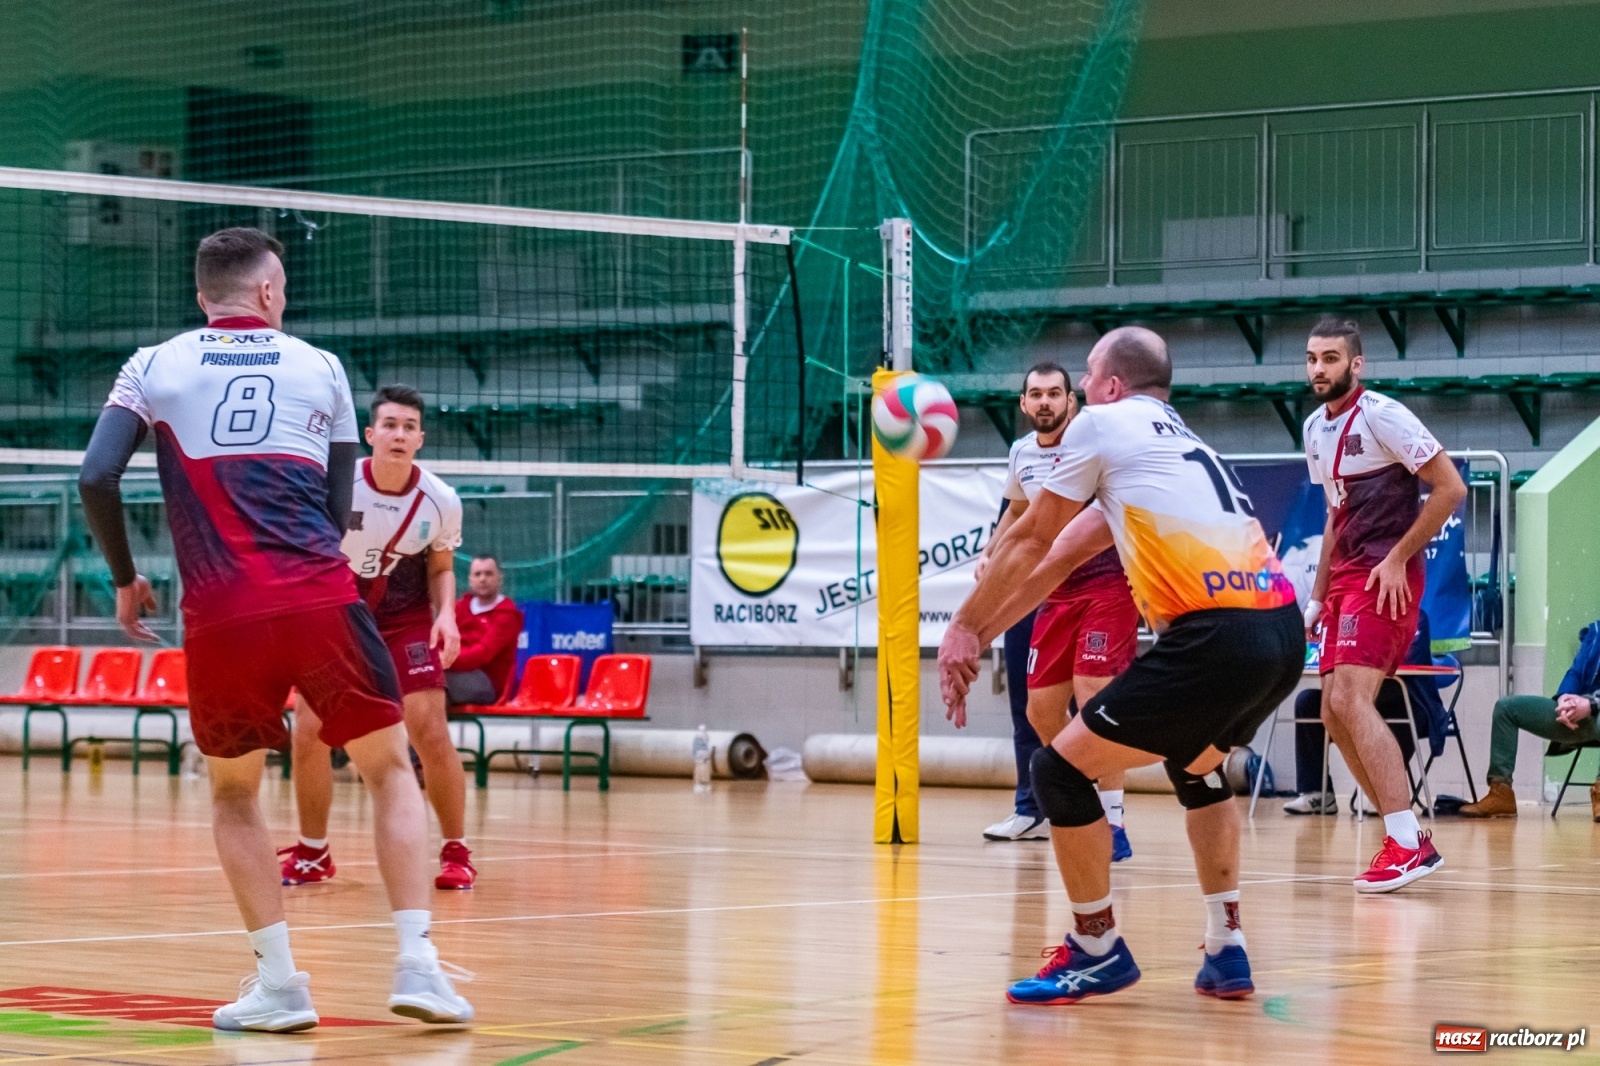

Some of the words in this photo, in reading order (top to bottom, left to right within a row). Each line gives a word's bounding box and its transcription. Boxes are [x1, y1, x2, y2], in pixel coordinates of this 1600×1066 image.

[211, 374, 275, 447] 8
[360, 548, 403, 579] 37
[816, 569, 875, 614] JEST
